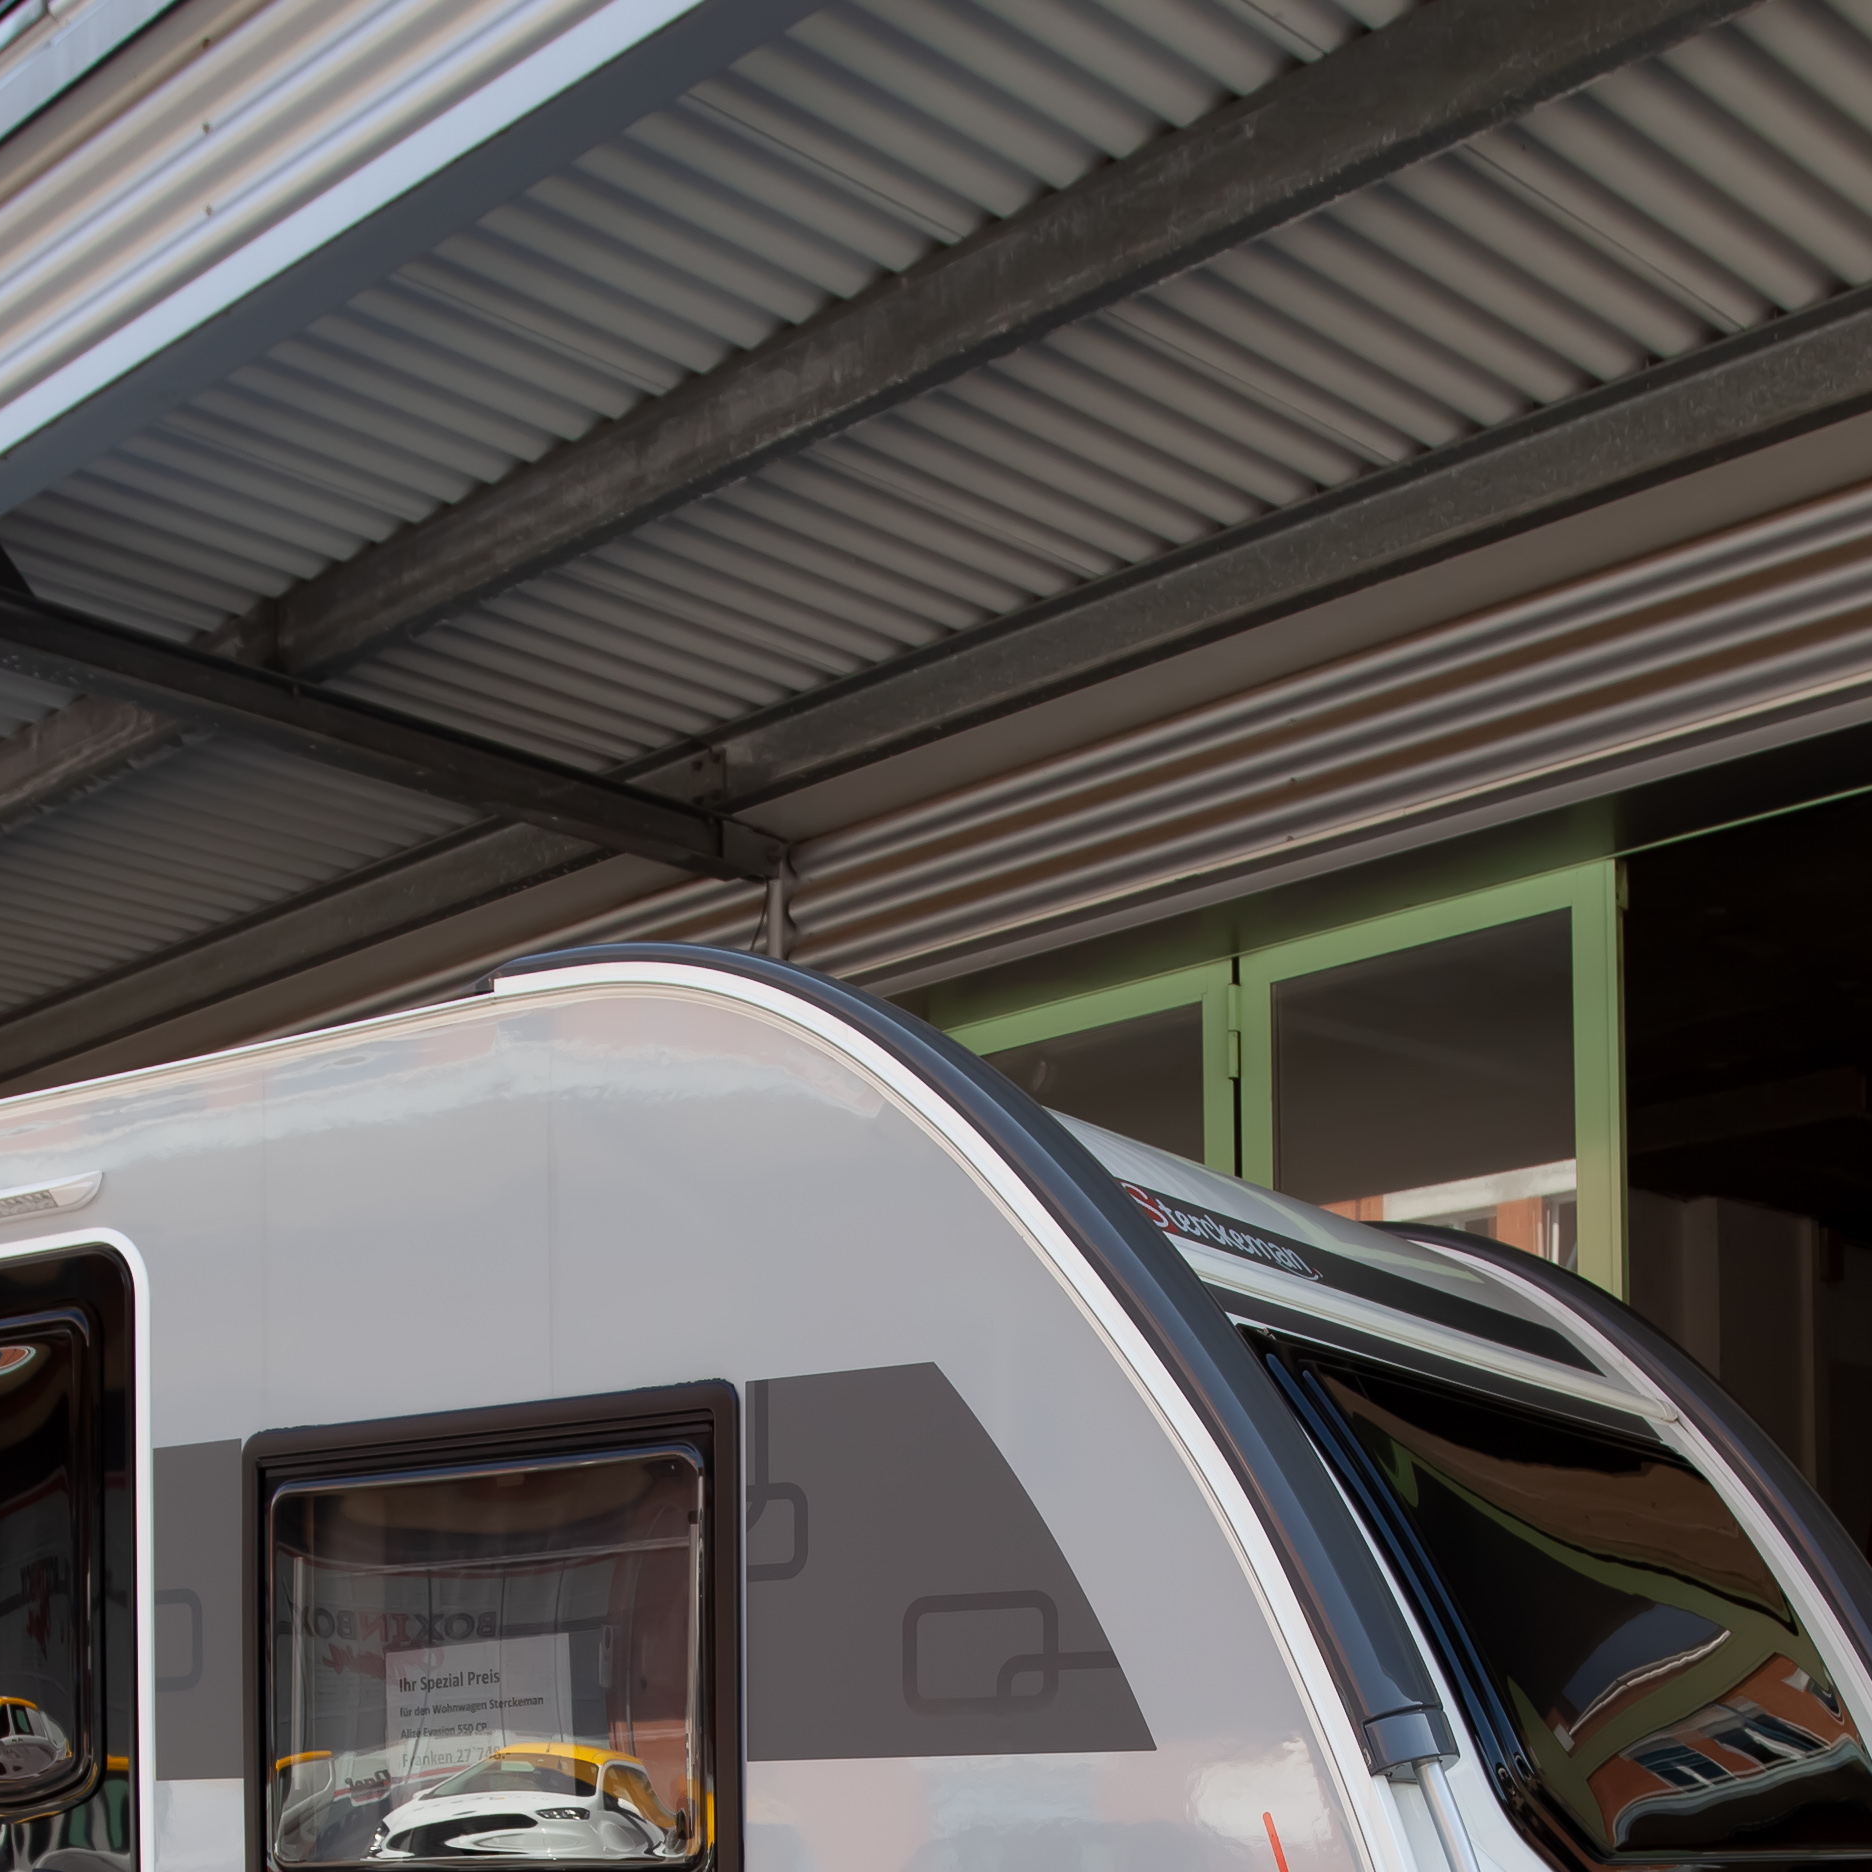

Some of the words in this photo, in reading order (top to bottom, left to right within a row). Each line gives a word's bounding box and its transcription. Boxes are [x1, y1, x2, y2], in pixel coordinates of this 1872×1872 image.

[1121, 1181, 1320, 1279] Sterckeman
[399, 1677, 417, 1693] Ihr
[420, 1671, 464, 1693] Spezial
[467, 1669, 500, 1686] Preis
[399, 1706, 412, 1718] für
[414, 1706, 431, 1717] den
[432, 1700, 488, 1714] Wohnwagen
[489, 1696, 544, 1710] Sterckeman
[423, 1725, 455, 1737] Evasion
[457, 1723, 474, 1734] 550
[476, 1722, 488, 1732] CP
